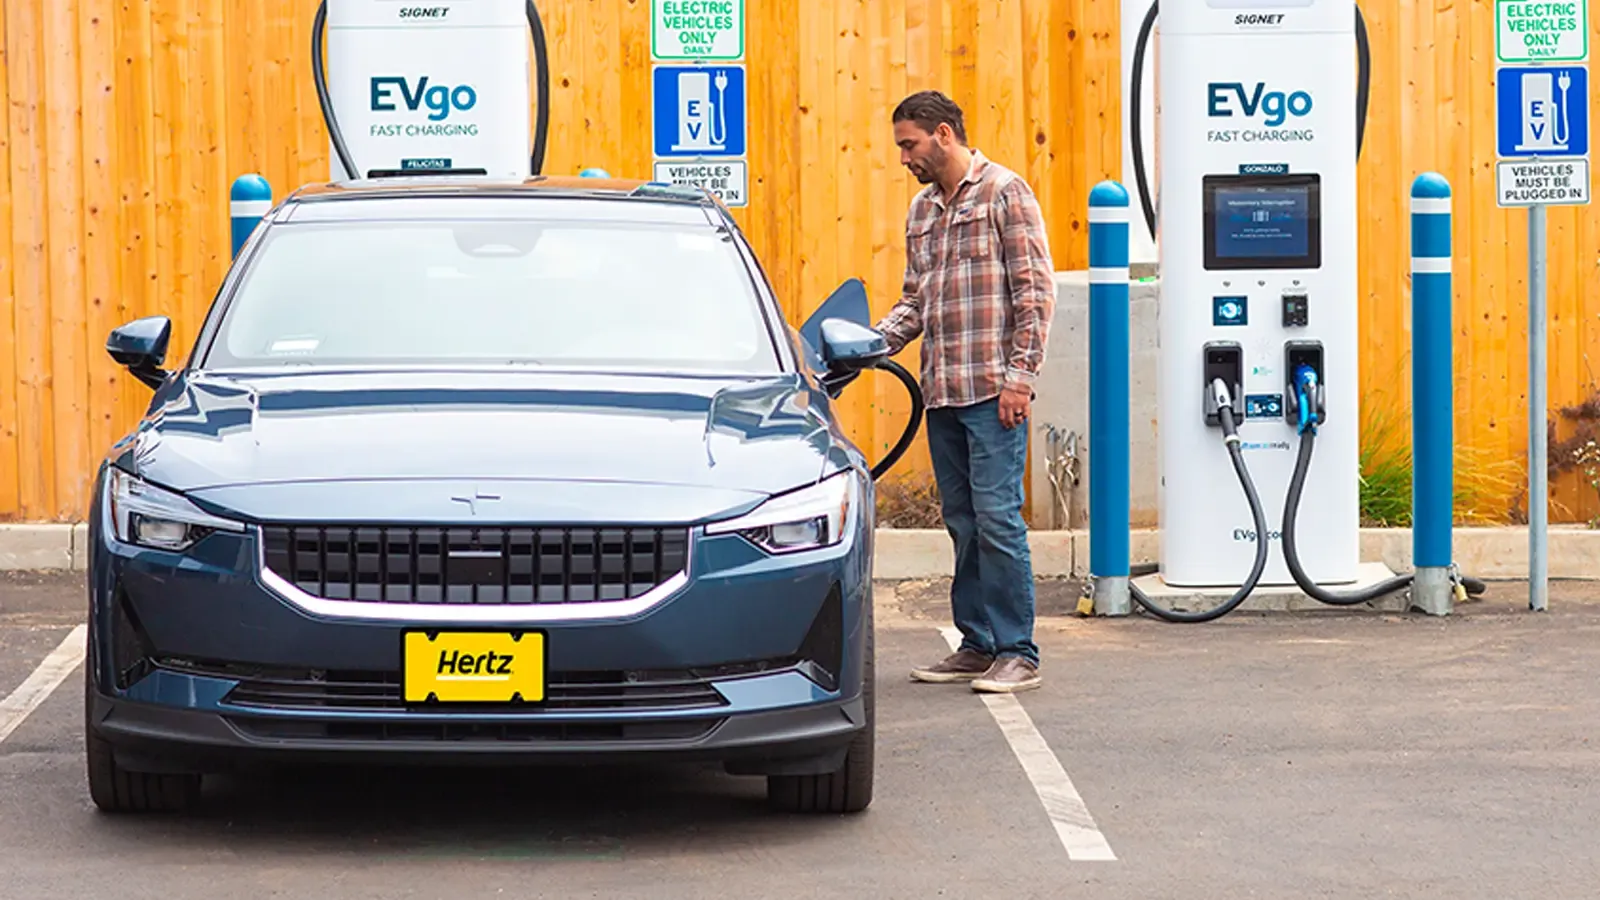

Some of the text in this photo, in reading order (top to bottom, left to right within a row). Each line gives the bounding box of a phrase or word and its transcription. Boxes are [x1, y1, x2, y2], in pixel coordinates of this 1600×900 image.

[399, 7, 449, 18] SIGNET
[663, 1, 733, 15] ELECTRIC
[1507, 3, 1576, 17] ELECTRIC
[663, 16, 733, 30] VEHICLES
[1234, 14, 1285, 25] SIGNET
[1507, 18, 1577, 32] VEHICLES
[678, 31, 717, 44] ONLY
[1523, 33, 1561, 46] ONLY
[683, 46, 713, 54] DAILY
[1528, 48, 1557, 56] DAILY
[370, 76, 477, 121] EVgo
[1207, 82, 1313, 127] EVgo
[370, 124, 479, 136] FAST CHARGING
[1207, 129, 1314, 142] FAST CHARGING
[669, 166, 731, 177] VEHICLES
[1512, 164, 1574, 176] VEHICLES
[711, 178, 728, 189] BE
[1515, 176, 1571, 188] MUST BE
[726, 190, 739, 199] IN
[1505, 188, 1582, 200] PLUGGED IN
[437, 650, 514, 674] Hertz
